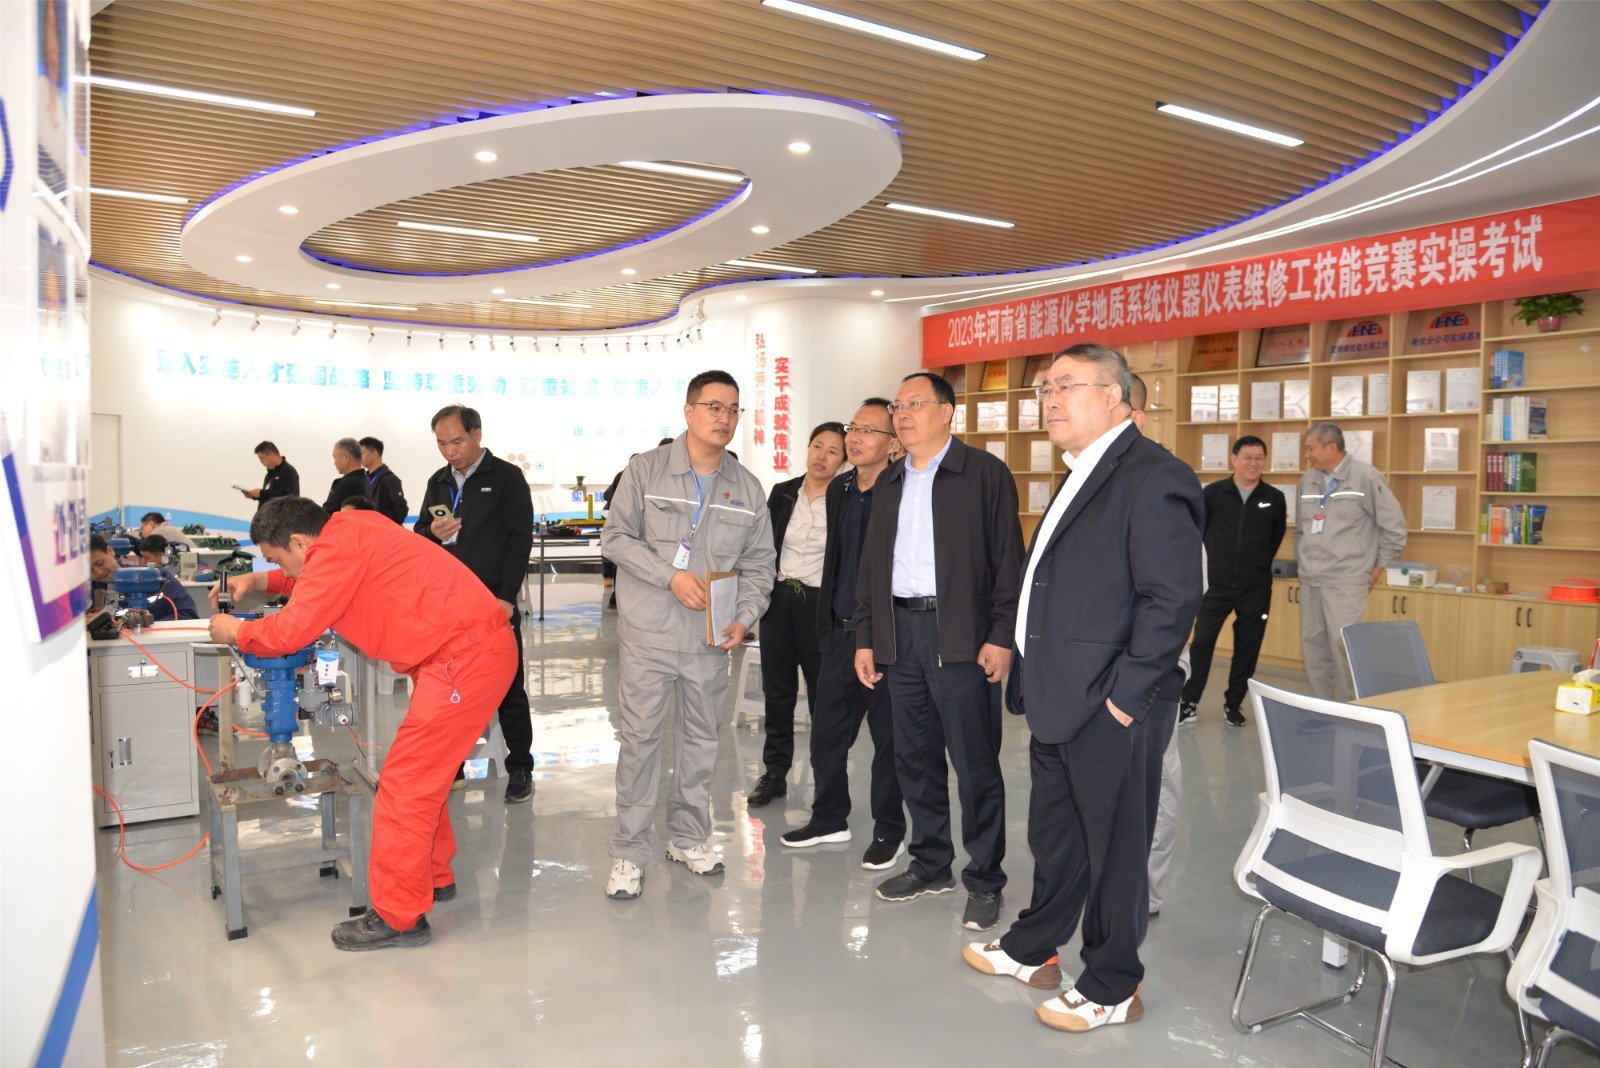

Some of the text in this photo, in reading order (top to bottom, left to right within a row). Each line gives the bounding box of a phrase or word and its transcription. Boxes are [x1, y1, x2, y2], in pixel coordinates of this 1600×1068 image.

[948, 214, 1543, 348] 2023年河南省能源化学地质系统仪器仪表维修工技能竞赛实操考试
[1352, 323, 1379, 337] HNE
[1435, 313, 1466, 328] HNE
[753, 333, 767, 447] 弘扬劳精神
[773, 357, 789, 470] 实干成就伟业
